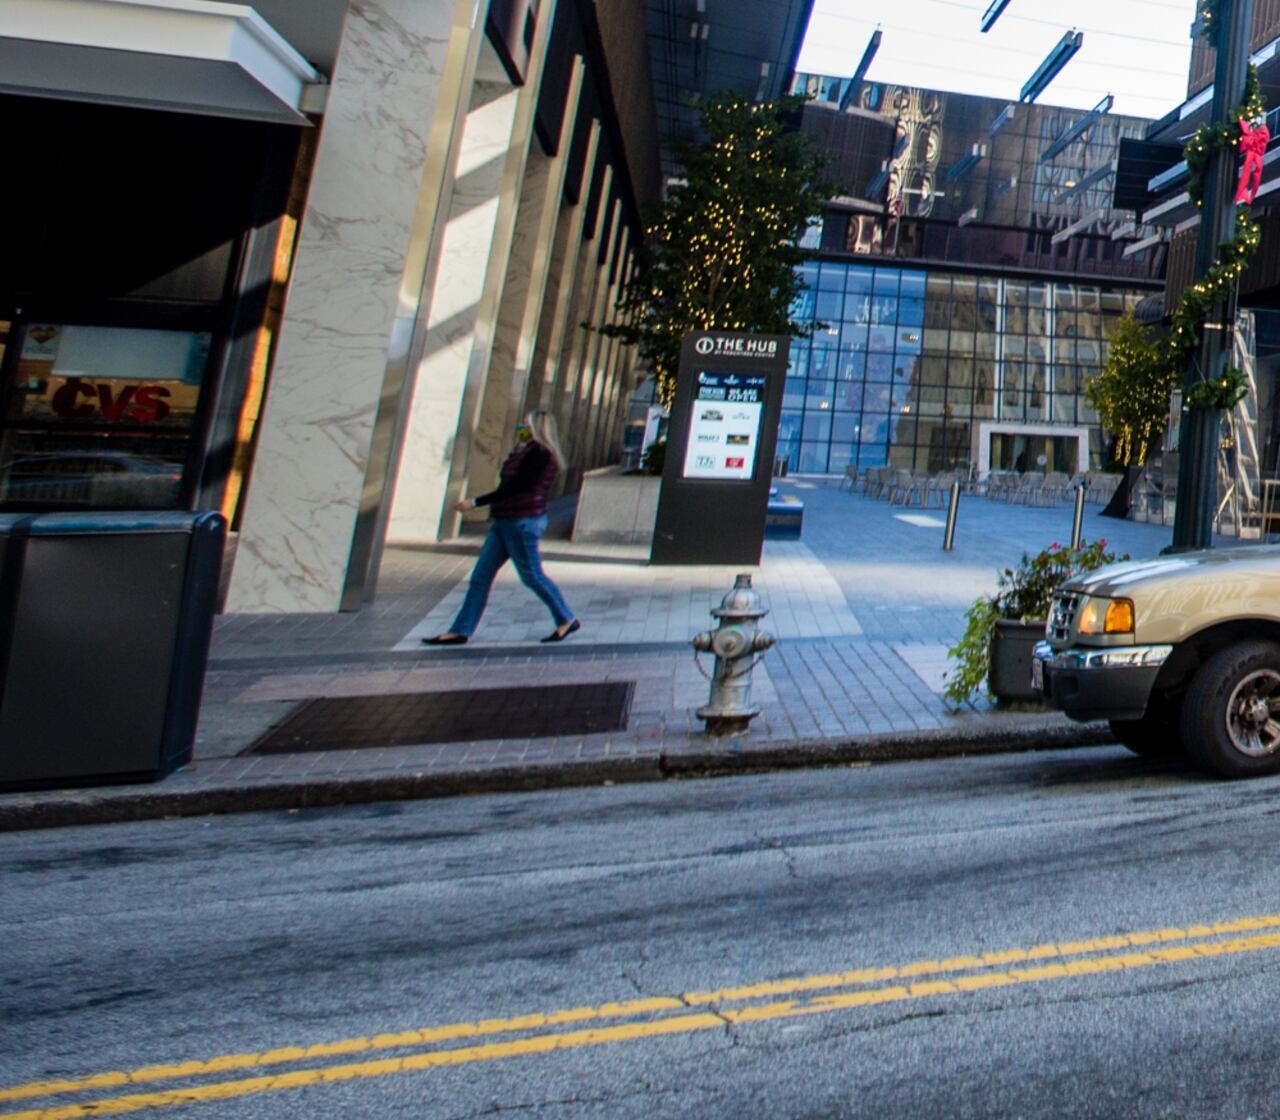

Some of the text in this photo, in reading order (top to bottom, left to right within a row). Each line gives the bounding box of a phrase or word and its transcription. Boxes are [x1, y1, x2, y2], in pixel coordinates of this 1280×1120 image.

[716, 338, 777, 353] THE HUB
[52, 379, 171, 422] CVS
